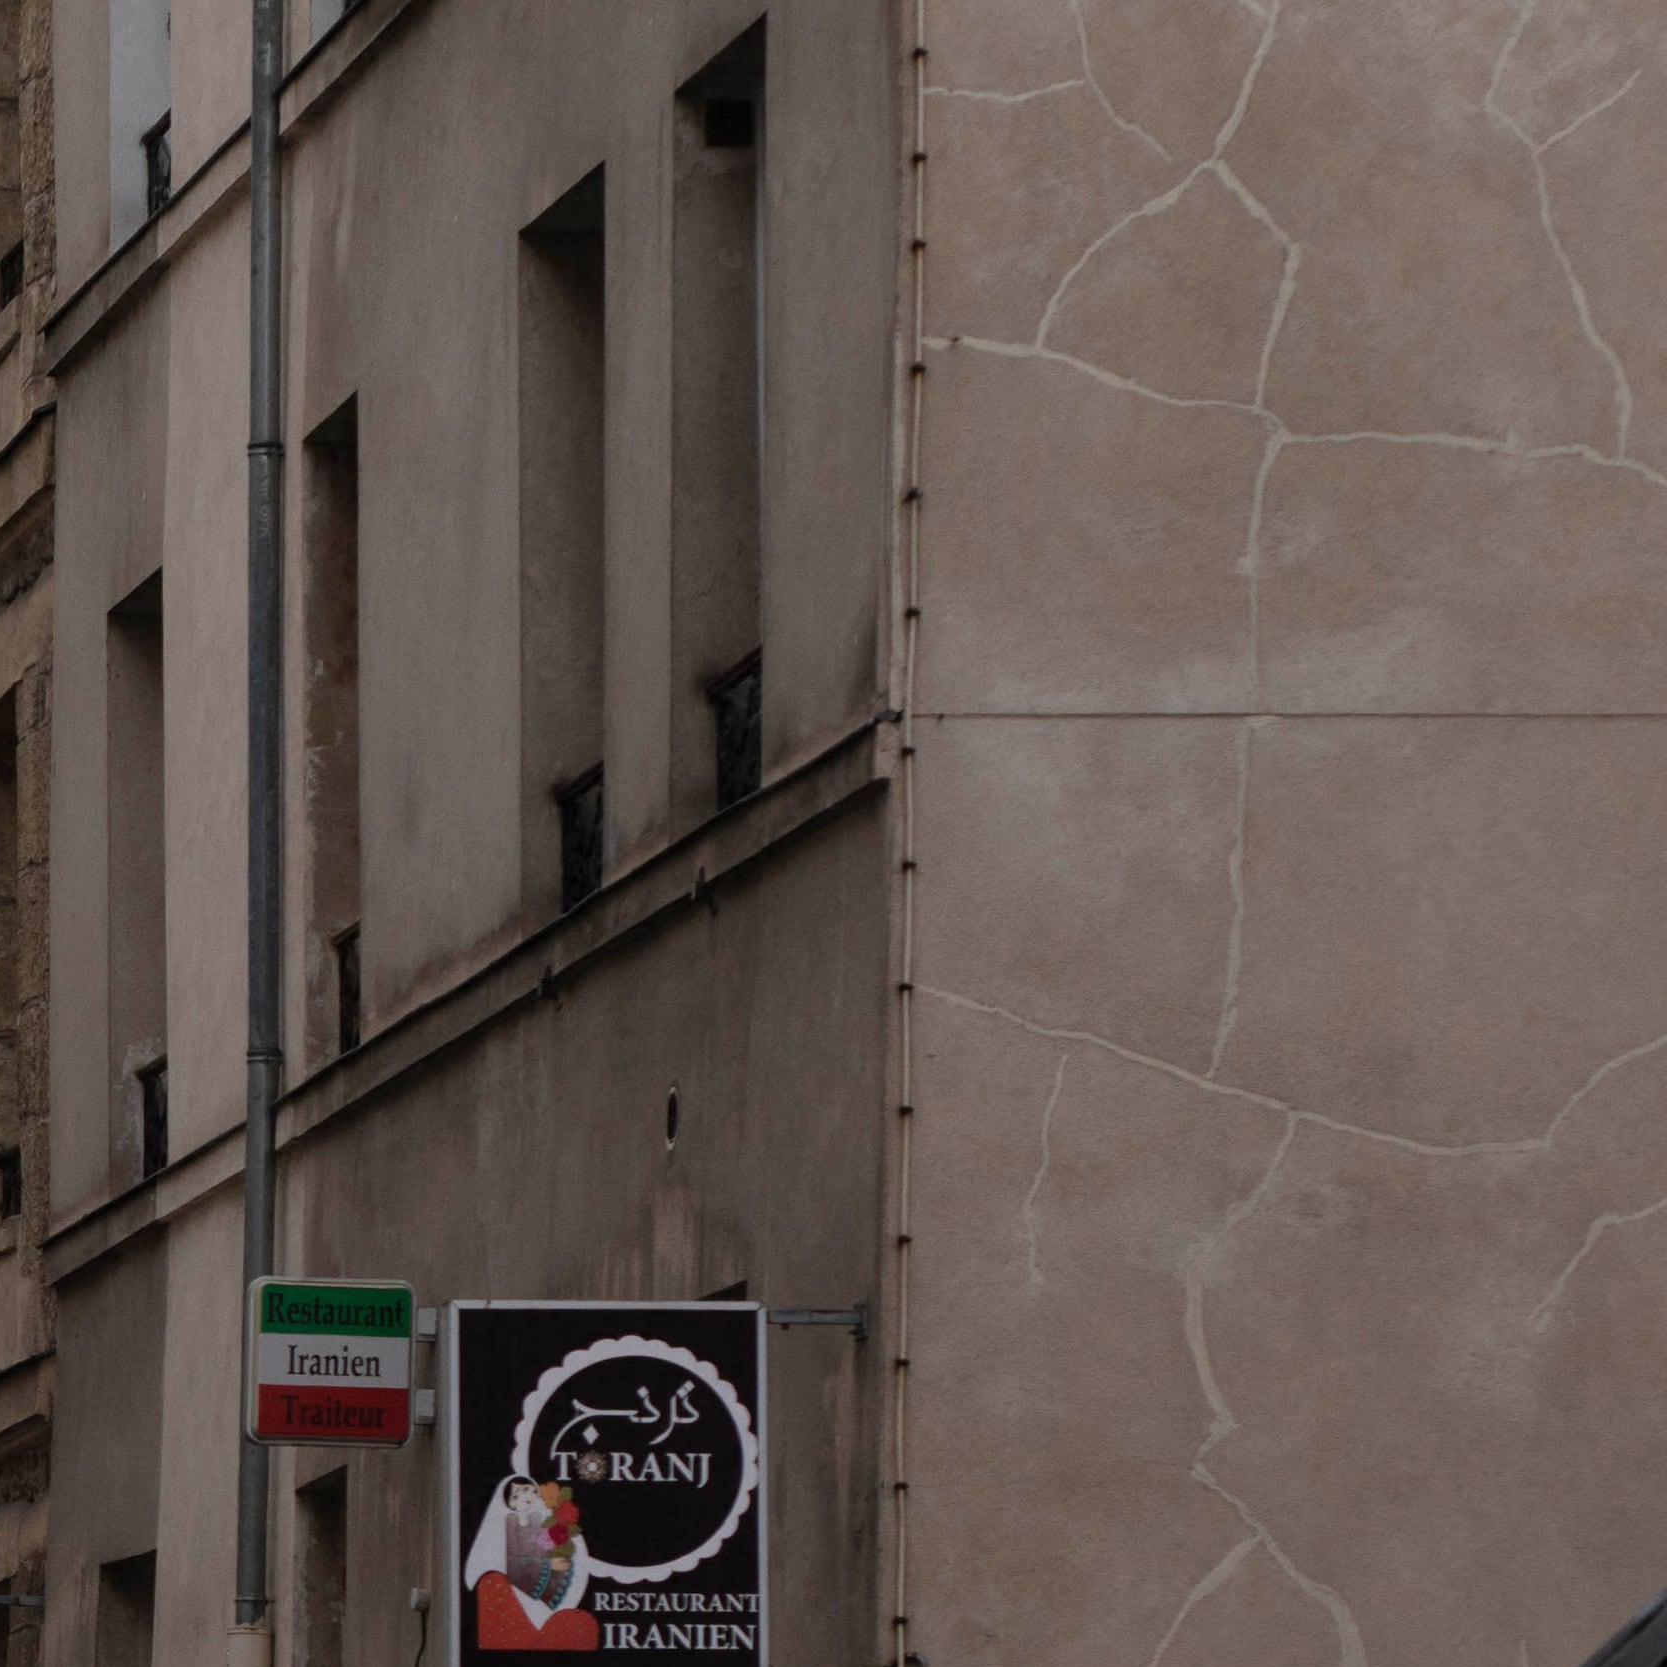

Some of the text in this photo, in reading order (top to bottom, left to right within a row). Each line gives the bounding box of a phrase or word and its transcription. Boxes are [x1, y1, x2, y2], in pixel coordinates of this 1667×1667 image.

[267, 1291, 407, 1329] Restaurant
[287, 1344, 382, 1378] Iranien
[280, 1394, 388, 1429] Traiteur
[594, 1591, 761, 1613] RESTAURANT
[603, 1622, 757, 1651] IRANIEN
